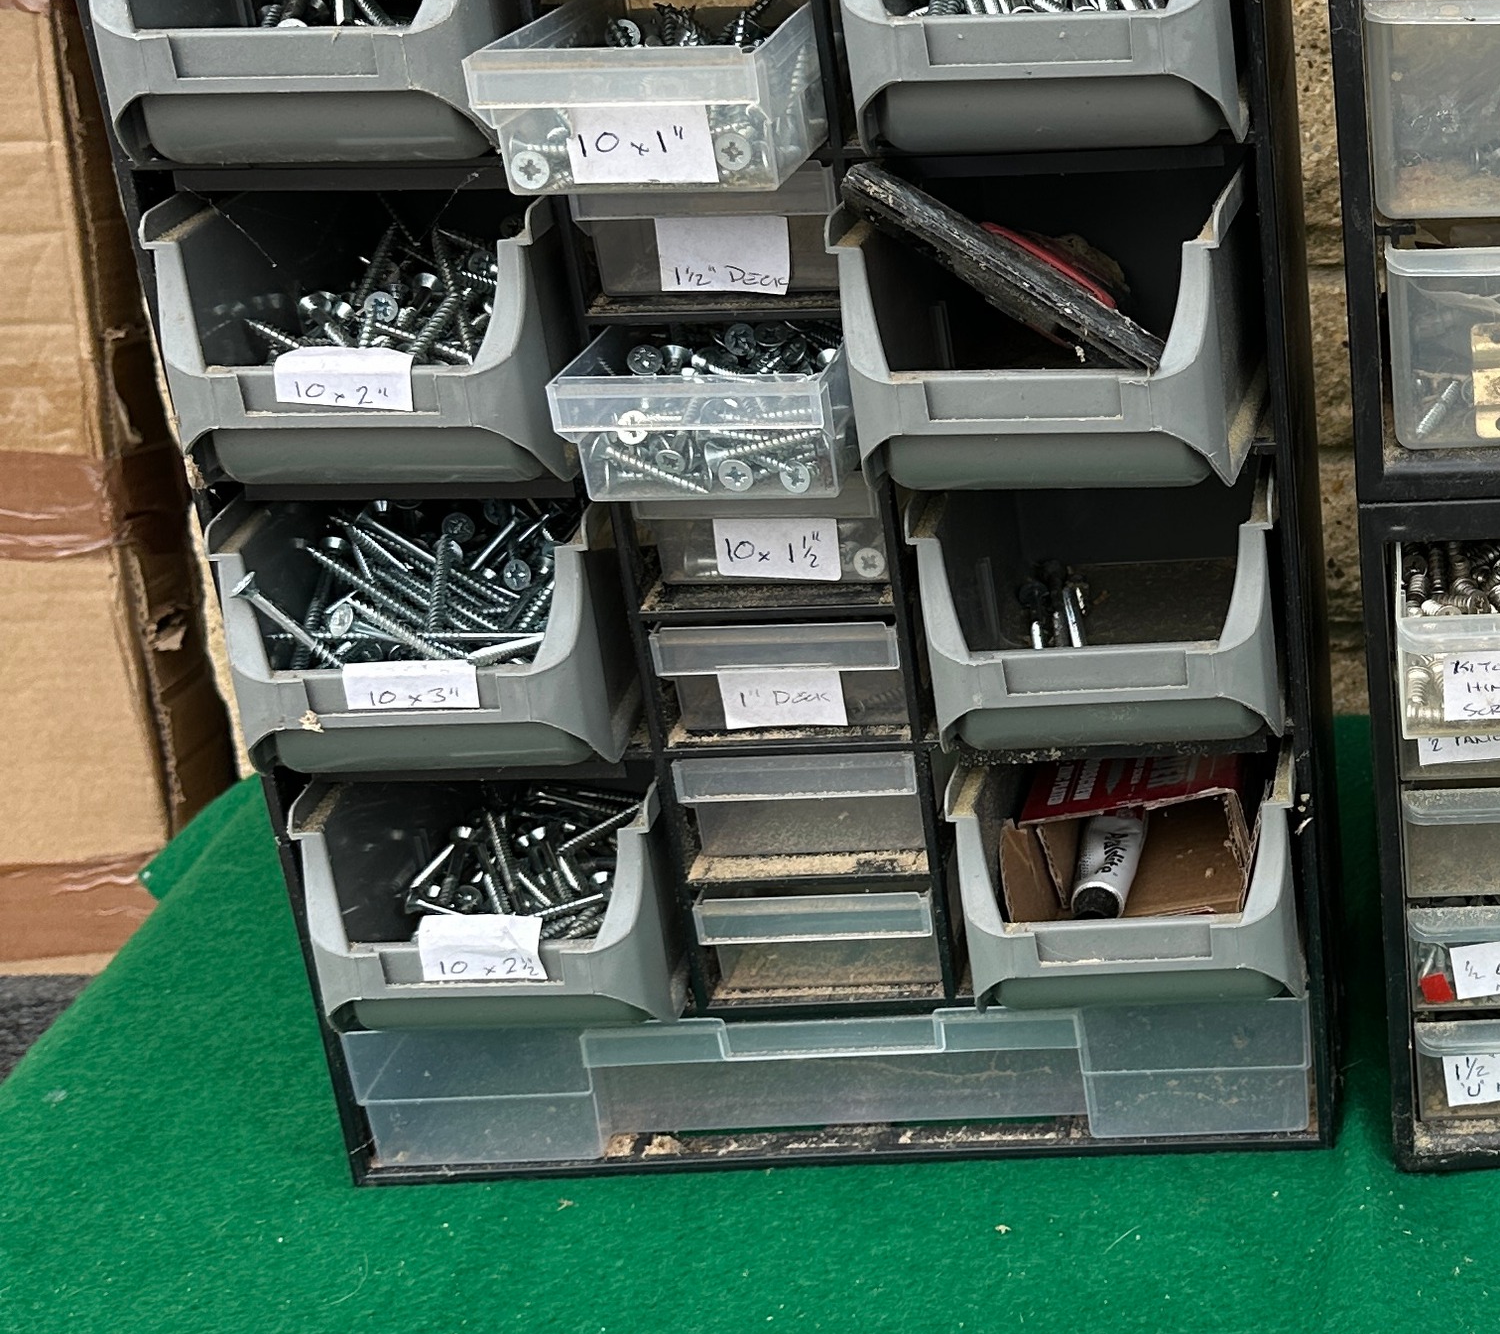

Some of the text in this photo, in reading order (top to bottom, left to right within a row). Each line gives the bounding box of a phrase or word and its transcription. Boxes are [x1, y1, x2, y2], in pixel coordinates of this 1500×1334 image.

[577, 131, 620, 158] 10
[656, 125, 684, 154] 1"
[294, 381, 325, 398] 10
[354, 385, 389, 409] 2"
[724, 537, 755, 563] 10
[369, 690, 396, 707] 10
[427, 687, 464, 709] 3"
[739, 689, 759, 708] 1"
[439, 960, 469, 975] 10
